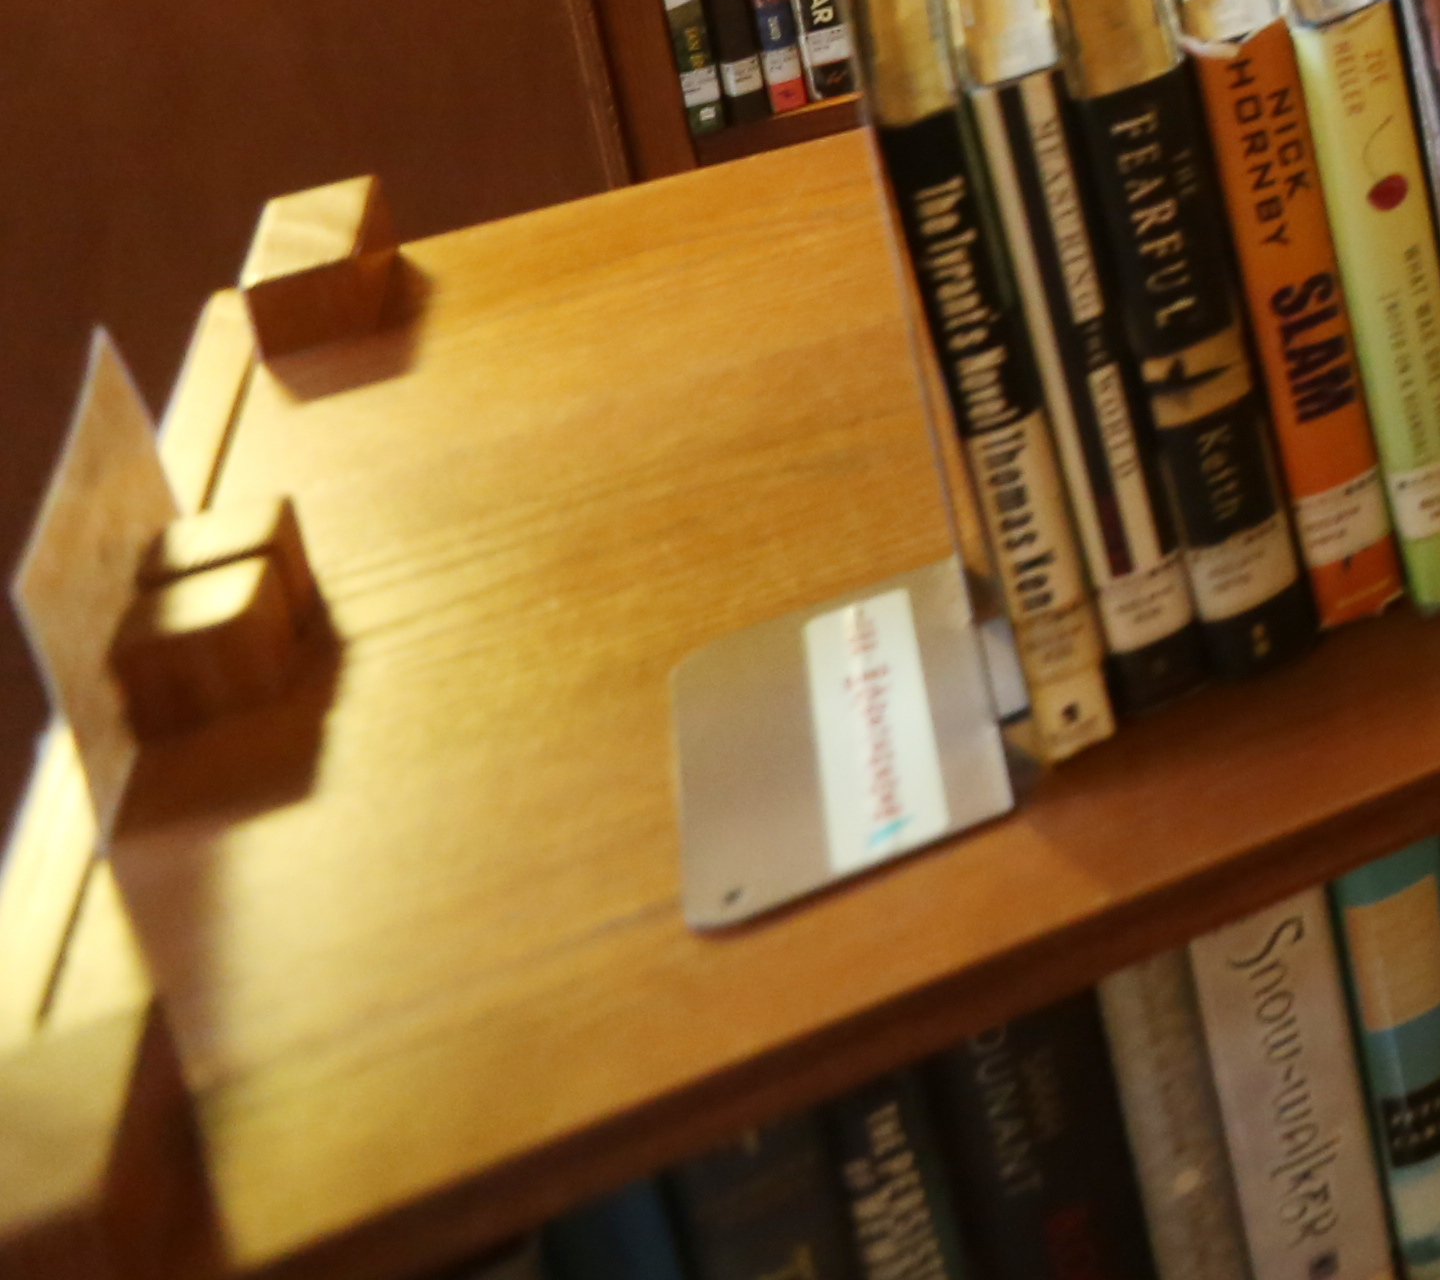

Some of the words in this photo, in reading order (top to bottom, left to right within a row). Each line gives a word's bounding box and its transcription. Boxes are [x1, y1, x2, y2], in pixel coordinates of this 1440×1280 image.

[1330, 39, 1368, 119] HELLER
[1223, 57, 1289, 254] HORNBY
[1264, 86, 1314, 203] NICK
[909, 175, 973, 237] The
[1112, 108, 1198, 331] FEARFUL
[1029, 117, 1100, 310] MEASURING
[1090, 371, 1142, 482] WORLD
[1269, 270, 1363, 424] SLAM
[1399, 244, 1429, 298] WHAT
[1414, 307, 1439, 352] WAS
[952, 344, 1021, 433] Novel
[977, 426, 1052, 552] Thomas
[1196, 425, 1245, 523] Keith
